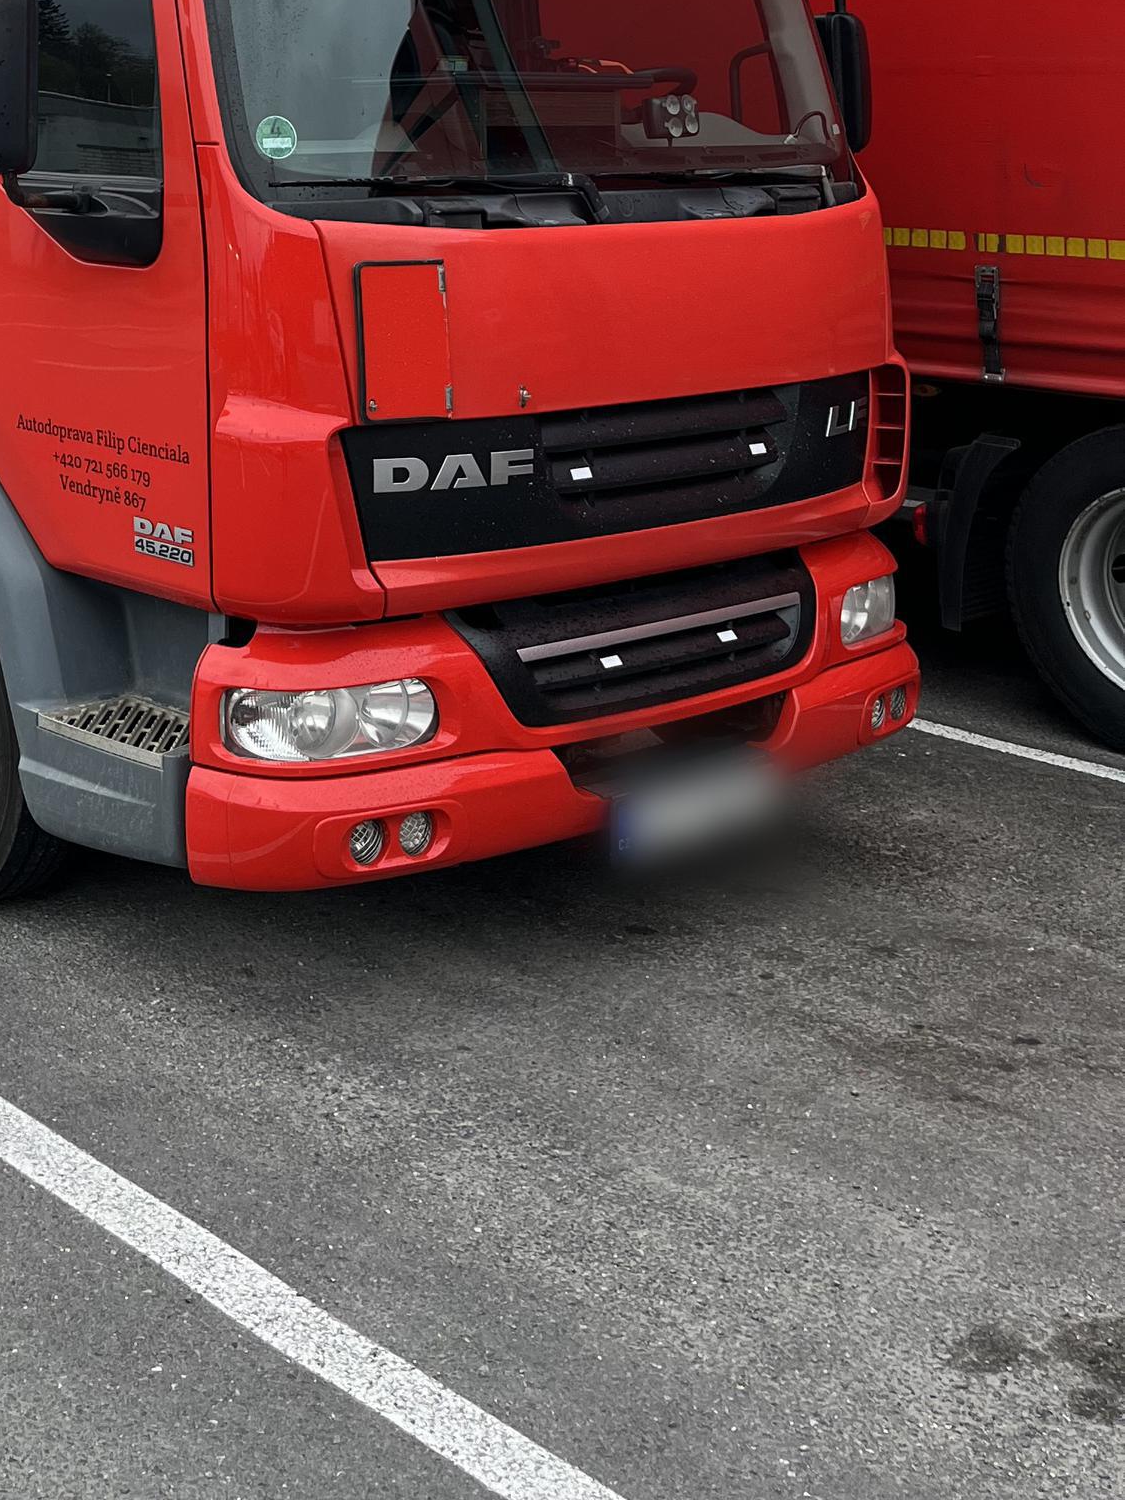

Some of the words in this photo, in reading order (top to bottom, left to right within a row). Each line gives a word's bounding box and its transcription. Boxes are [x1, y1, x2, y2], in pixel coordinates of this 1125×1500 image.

[16, 414, 94, 444] Autodoprava
[95, 429, 125, 454] Filip
[127, 436, 191, 465] Cienciala
[52, 451, 82, 469] +420
[84, 458, 104, 475] 721
[105, 461, 128, 480] 566
[130, 468, 151, 488] 179
[373, 448, 534, 494] DAF
[59, 473, 121, 504] Vendryně
[124, 490, 147, 512] 867
[133, 516, 194, 544] DAF
[135, 538, 192, 564] 45.220
